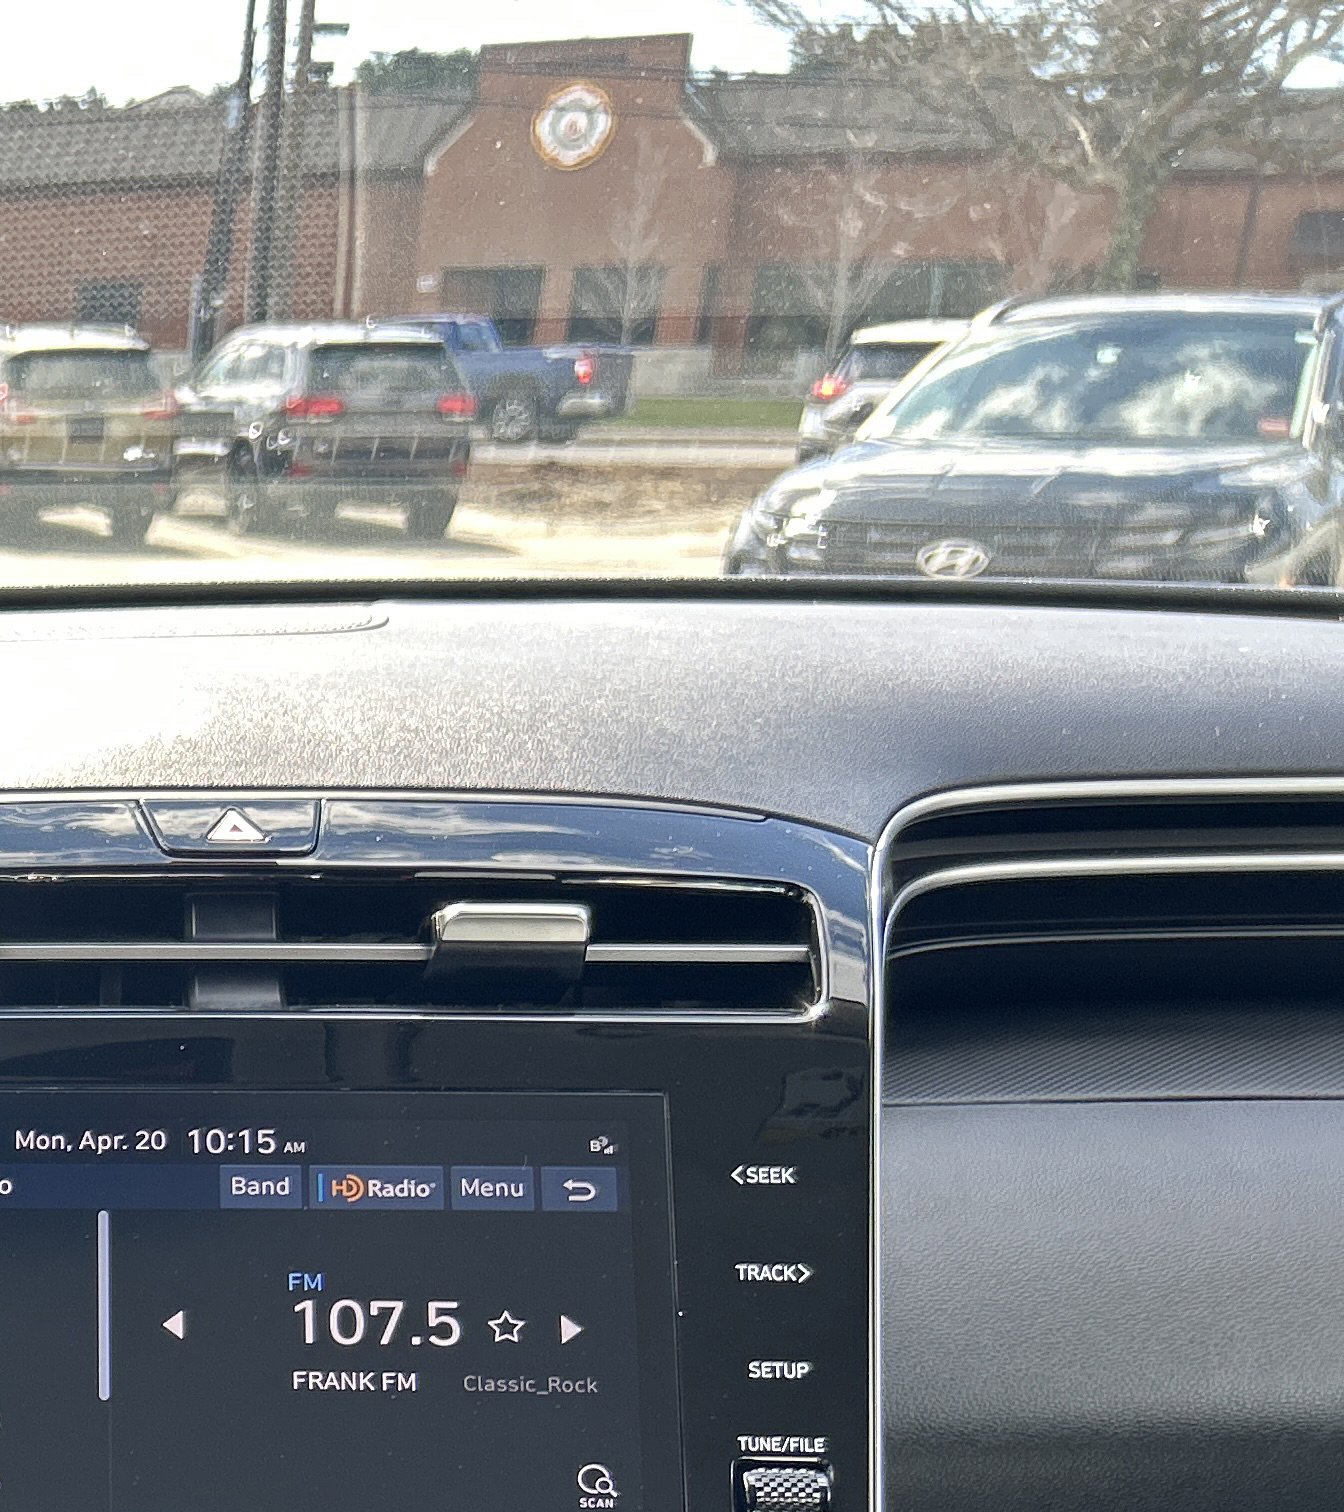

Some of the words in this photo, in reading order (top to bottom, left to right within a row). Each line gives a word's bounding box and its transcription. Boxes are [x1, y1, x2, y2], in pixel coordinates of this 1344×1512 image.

[15, 1129, 73, 1153] Mon,
[78, 1130, 128, 1155] Apr.
[135, 1129, 167, 1151] 20
[187, 1127, 277, 1155] 10:15
[283, 1141, 306, 1154] AM
[231, 1176, 291, 1197] Band
[461, 1177, 524, 1198] Menu
[288, 1272, 324, 1292] FM
[294, 1299, 461, 1347] 107.5
[748, 1361, 812, 1379] SETUP
[292, 1370, 376, 1391] FRANK
[381, 1372, 417, 1392] FM
[463, 1374, 599, 1395] Classic_Rock
[737, 1436, 825, 1453] TUNE/FILE
[579, 1497, 614, 1509] SCAN
